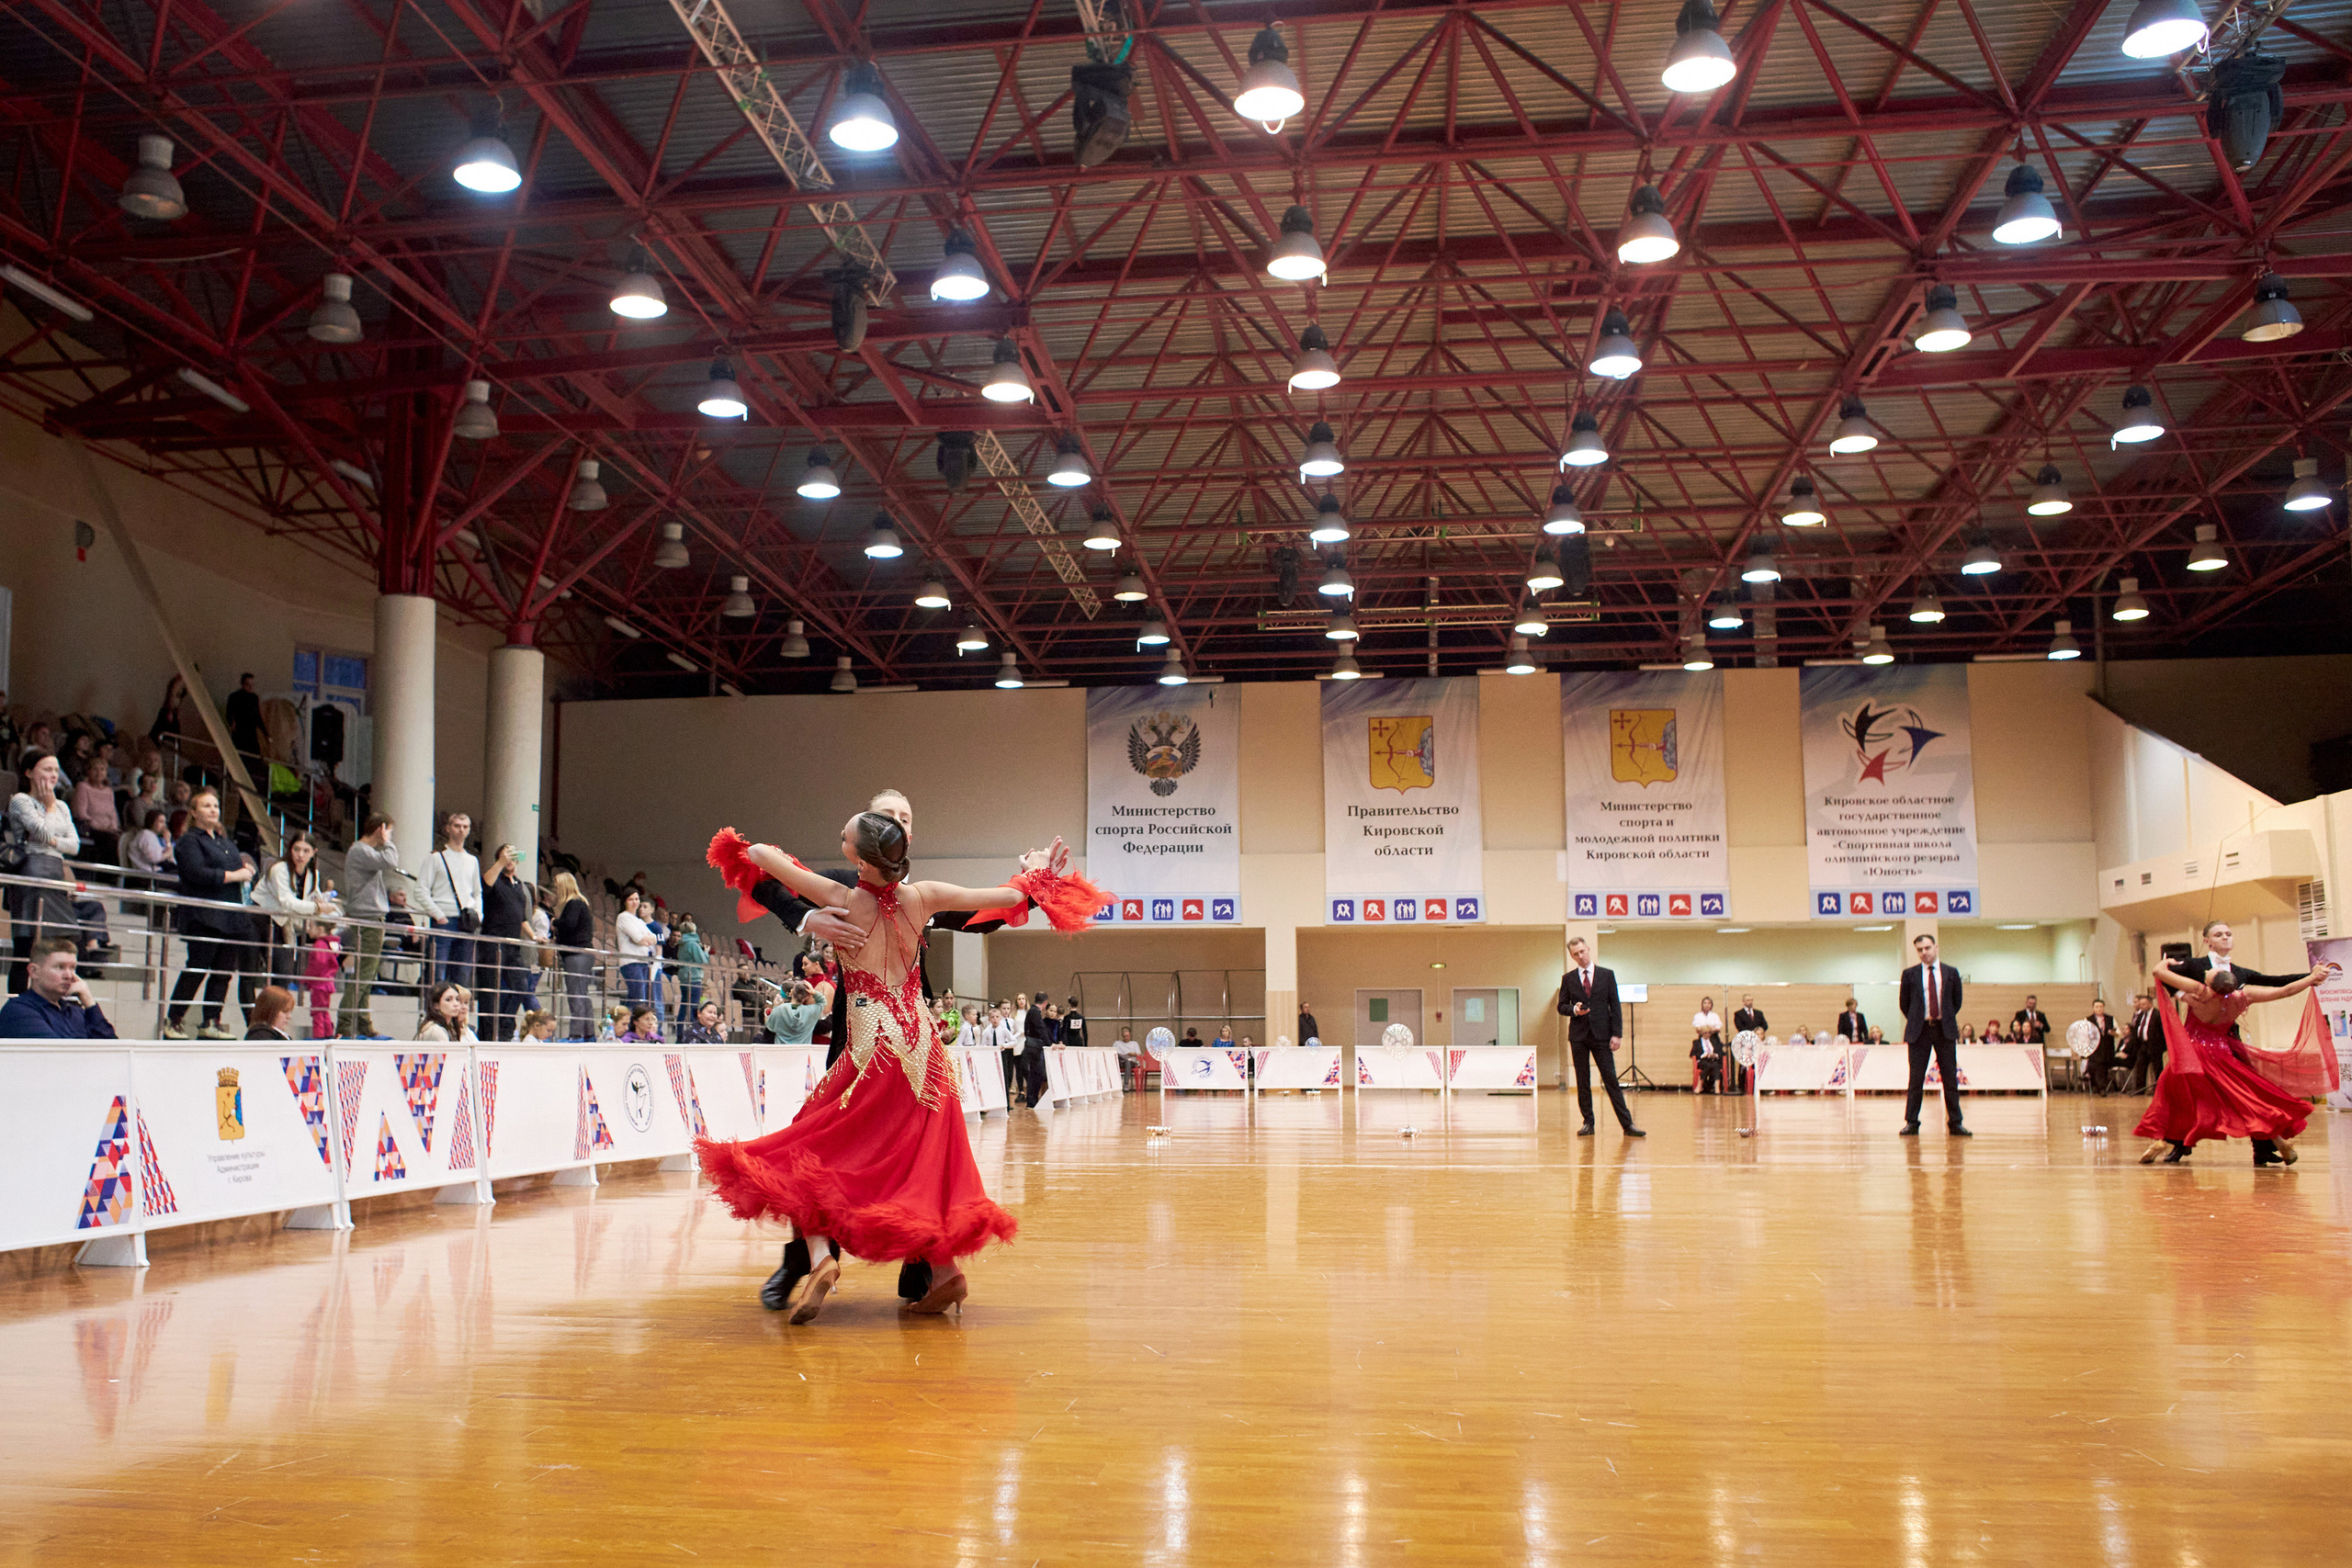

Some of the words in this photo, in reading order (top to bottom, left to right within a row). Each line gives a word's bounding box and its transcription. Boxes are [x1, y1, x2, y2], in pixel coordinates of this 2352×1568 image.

[1600, 801, 1692, 813] Министерство
[1825, 796, 1890, 807] Кировское
[1893, 795, 1954, 806] областное
[1112, 806, 1216, 818] Министерство
[1347, 806, 1459, 819] Правительство
[1839, 812, 1941, 823] государственное
[1620, 818, 1663, 829] спорта
[1667, 818, 1674, 827] и
[1095, 826, 1144, 837] спорта
[1148, 823, 1232, 834] Российской
[1363, 825, 1443, 839] Кировской
[1817, 827, 1888, 836] автономное
[1892, 827, 1966, 837] учреждение
[1575, 834, 1655, 845] молодежной
[1658, 834, 1720, 842] политики
[1832, 840, 1910, 851] «Спортивная
[1123, 841, 1204, 855] Федерации
[1374, 844, 1433, 856] области
[1586, 850, 1656, 862] Кировской
[1659, 849, 1710, 859] области
[1825, 853, 1911, 863] олимпийского
[1914, 853, 1961, 863] резерва
[1863, 866, 1923, 876] «Юность»
